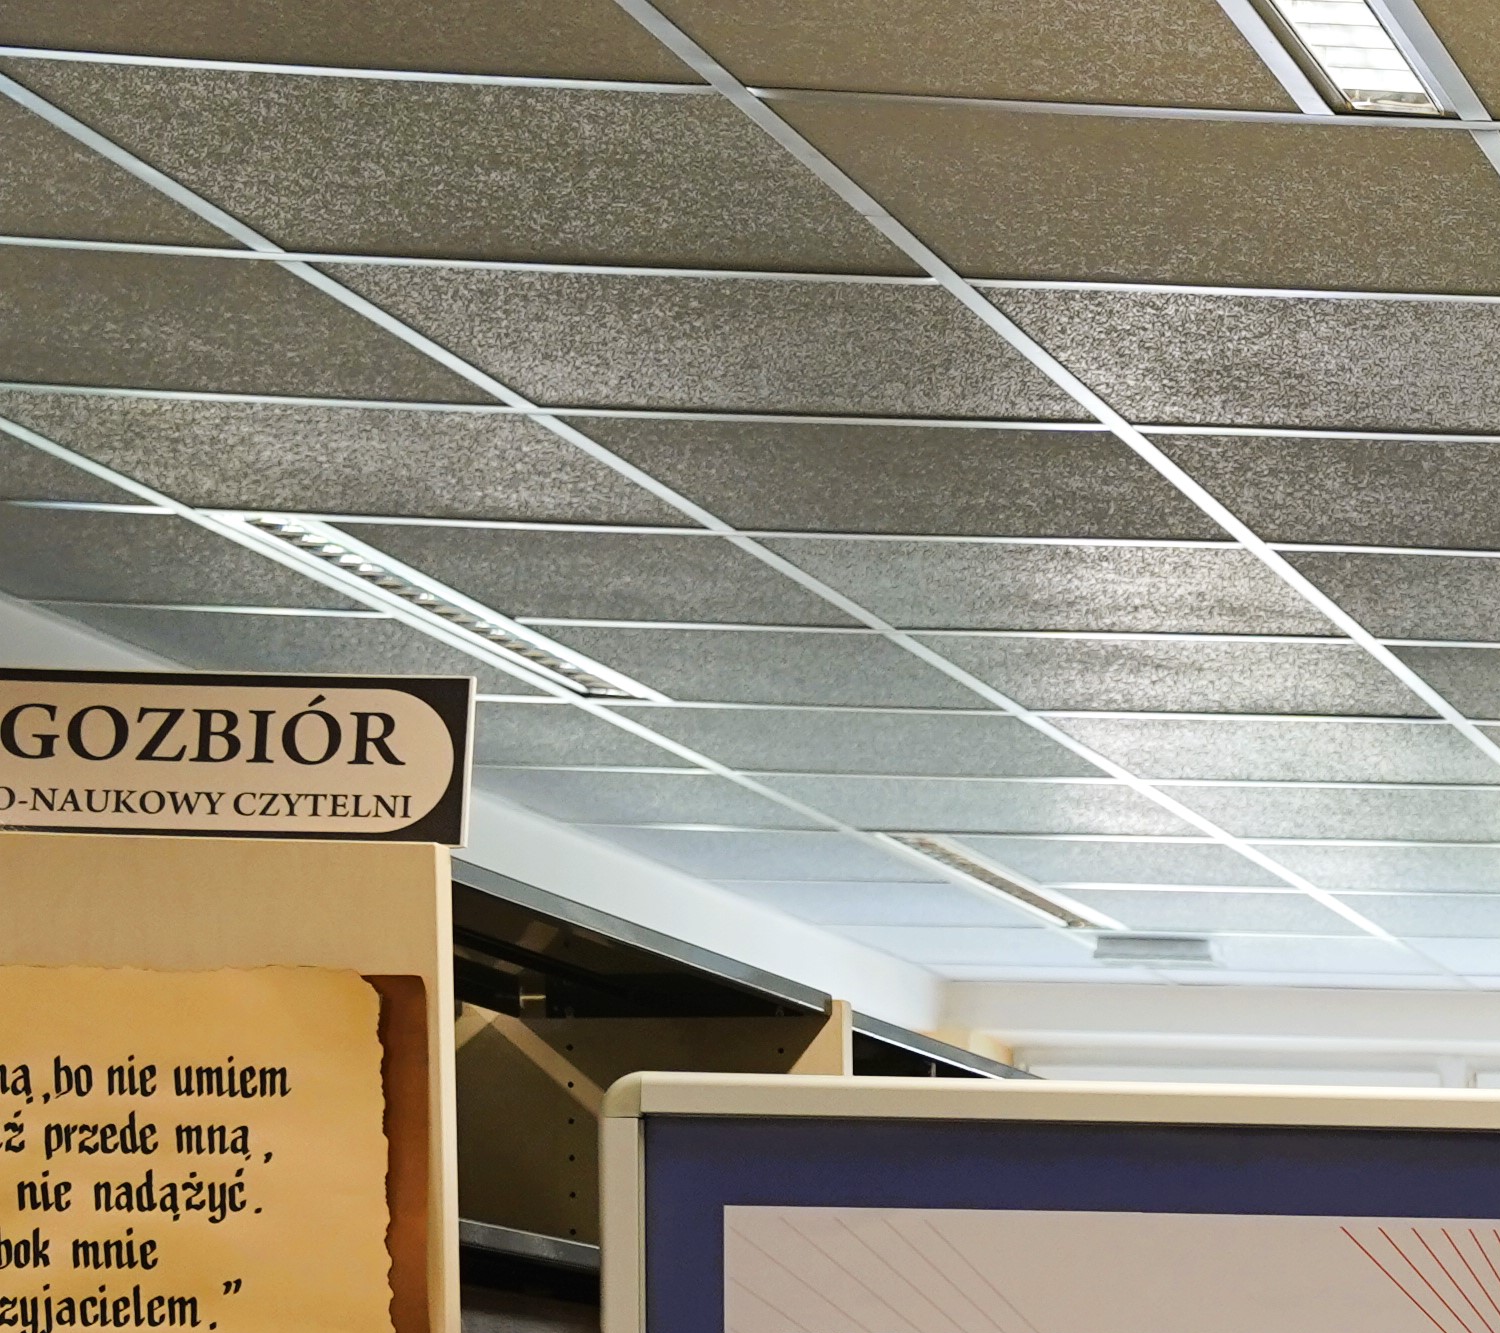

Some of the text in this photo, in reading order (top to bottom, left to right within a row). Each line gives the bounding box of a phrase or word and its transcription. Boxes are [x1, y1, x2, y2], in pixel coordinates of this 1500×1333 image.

[233, 792, 412, 819] CZYTELNI
[107, 1054, 157, 1098] nie
[173, 1055, 292, 1099] umiem
[44, 1110, 159, 1161] przede
[16, 1169, 72, 1213] nie
[72, 1227, 159, 1271] mnie
